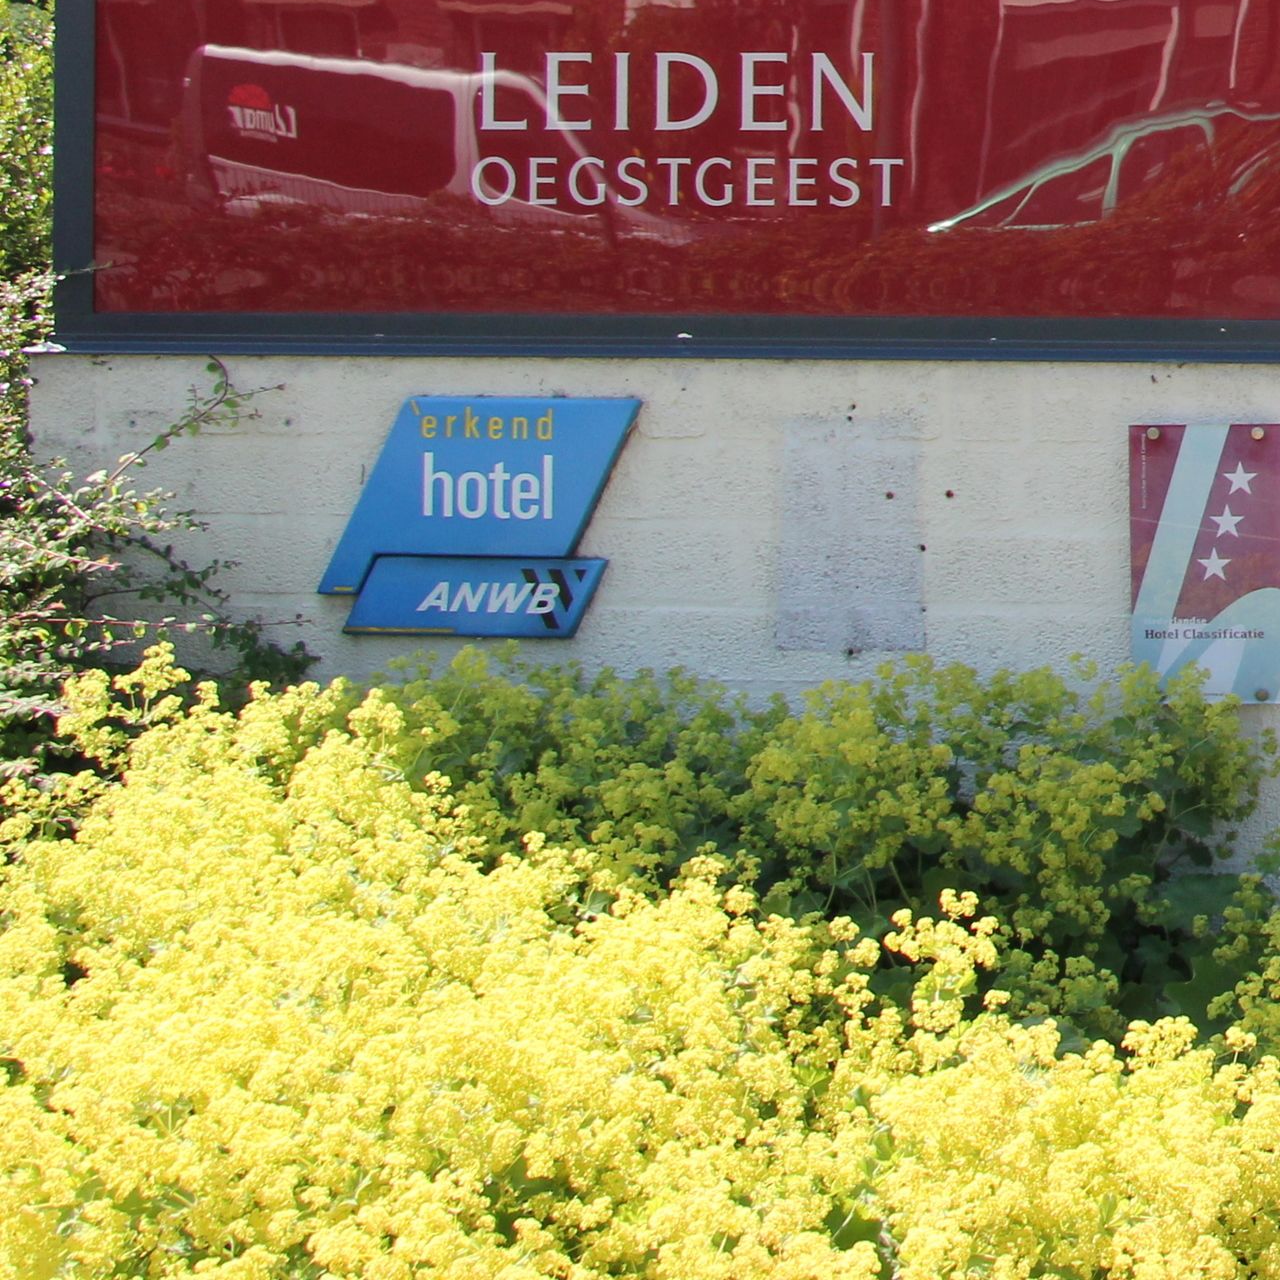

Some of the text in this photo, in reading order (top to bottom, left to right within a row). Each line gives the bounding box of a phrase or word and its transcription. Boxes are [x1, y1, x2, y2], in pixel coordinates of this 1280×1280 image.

[479, 51, 875, 133] LEIDEN
[471, 155, 904, 209] OEGSTGEEST
[421, 406, 554, 441] erkend
[423, 451, 553, 520] hotel
[416, 581, 560, 615] ANWB
[1144, 628, 1265, 640] Hotel Classificatie
